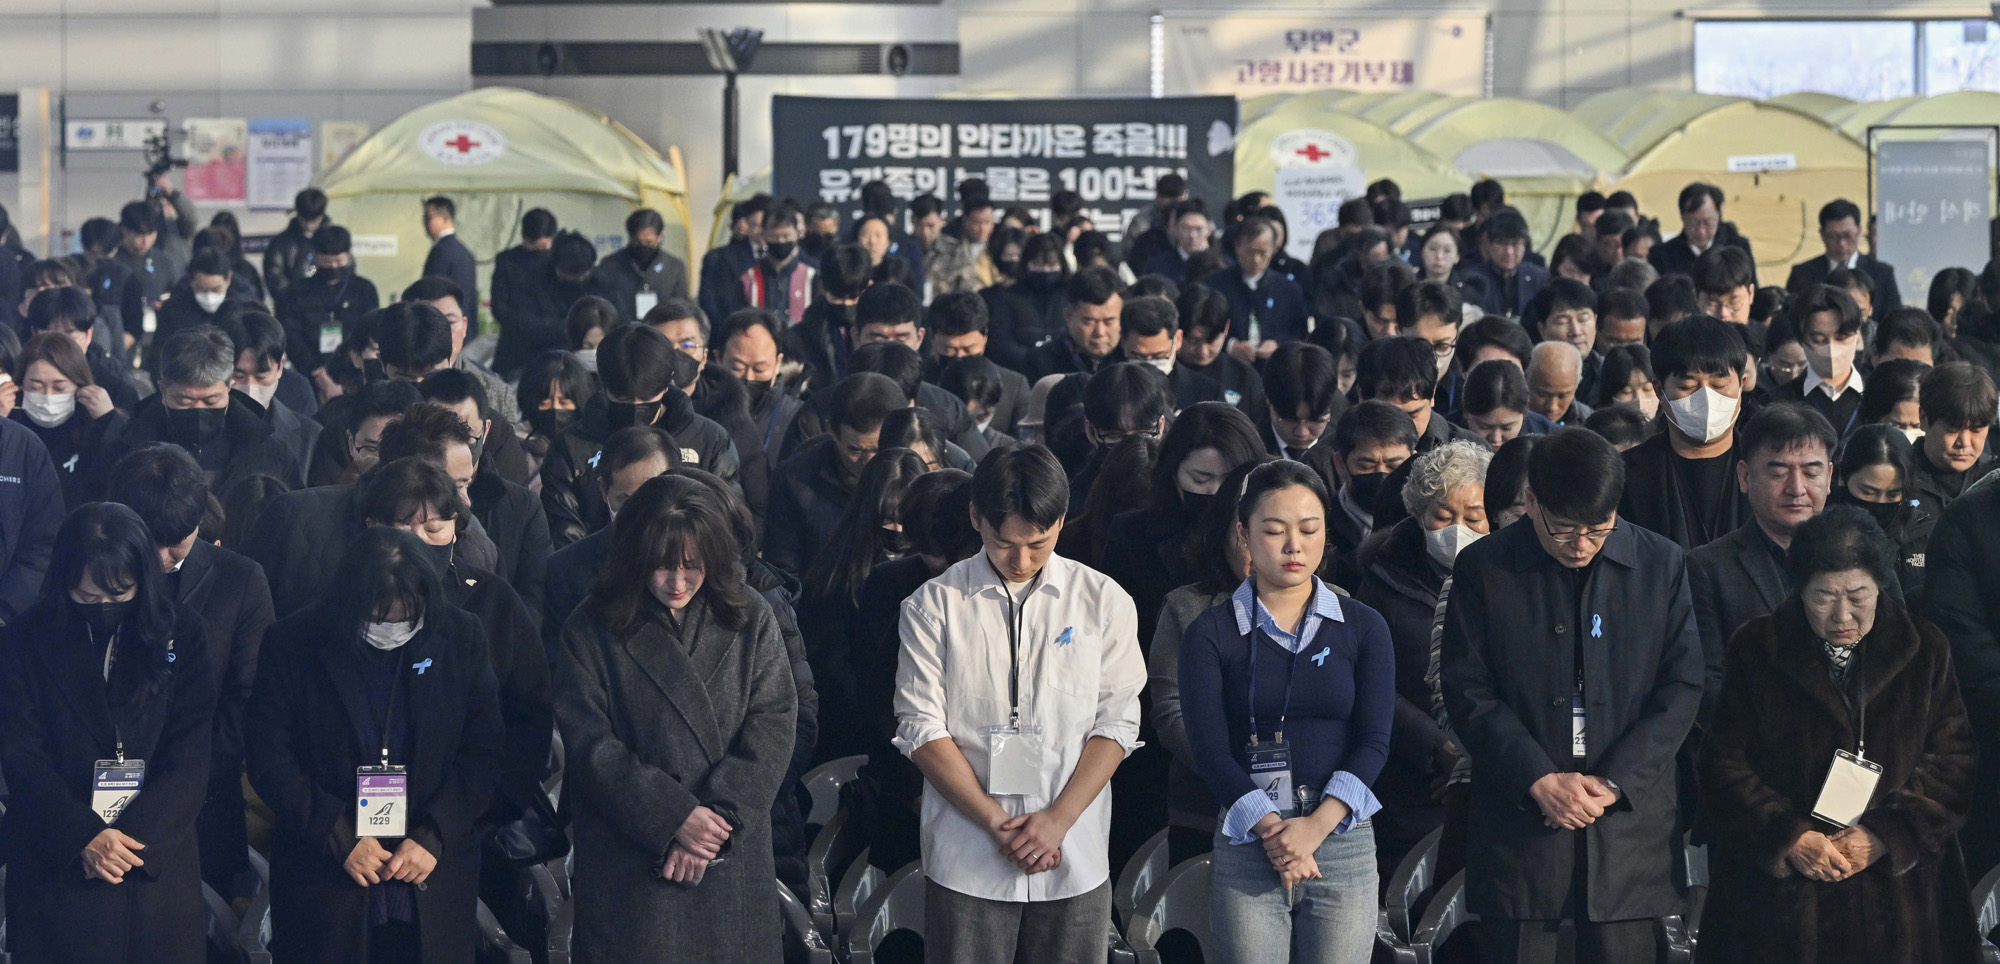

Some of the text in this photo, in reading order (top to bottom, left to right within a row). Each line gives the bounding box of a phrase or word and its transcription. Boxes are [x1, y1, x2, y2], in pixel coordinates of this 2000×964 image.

[1285, 28, 1361, 53] 무안군
[1234, 58, 1415, 85] 고향사랑기부제
[821, 122, 1188, 160] 179명의 안타까운 죽음!!!
[1059, 165, 1189, 201] 100년
[1266, 792, 1279, 801] 29
[369, 816, 391, 825] 1229
